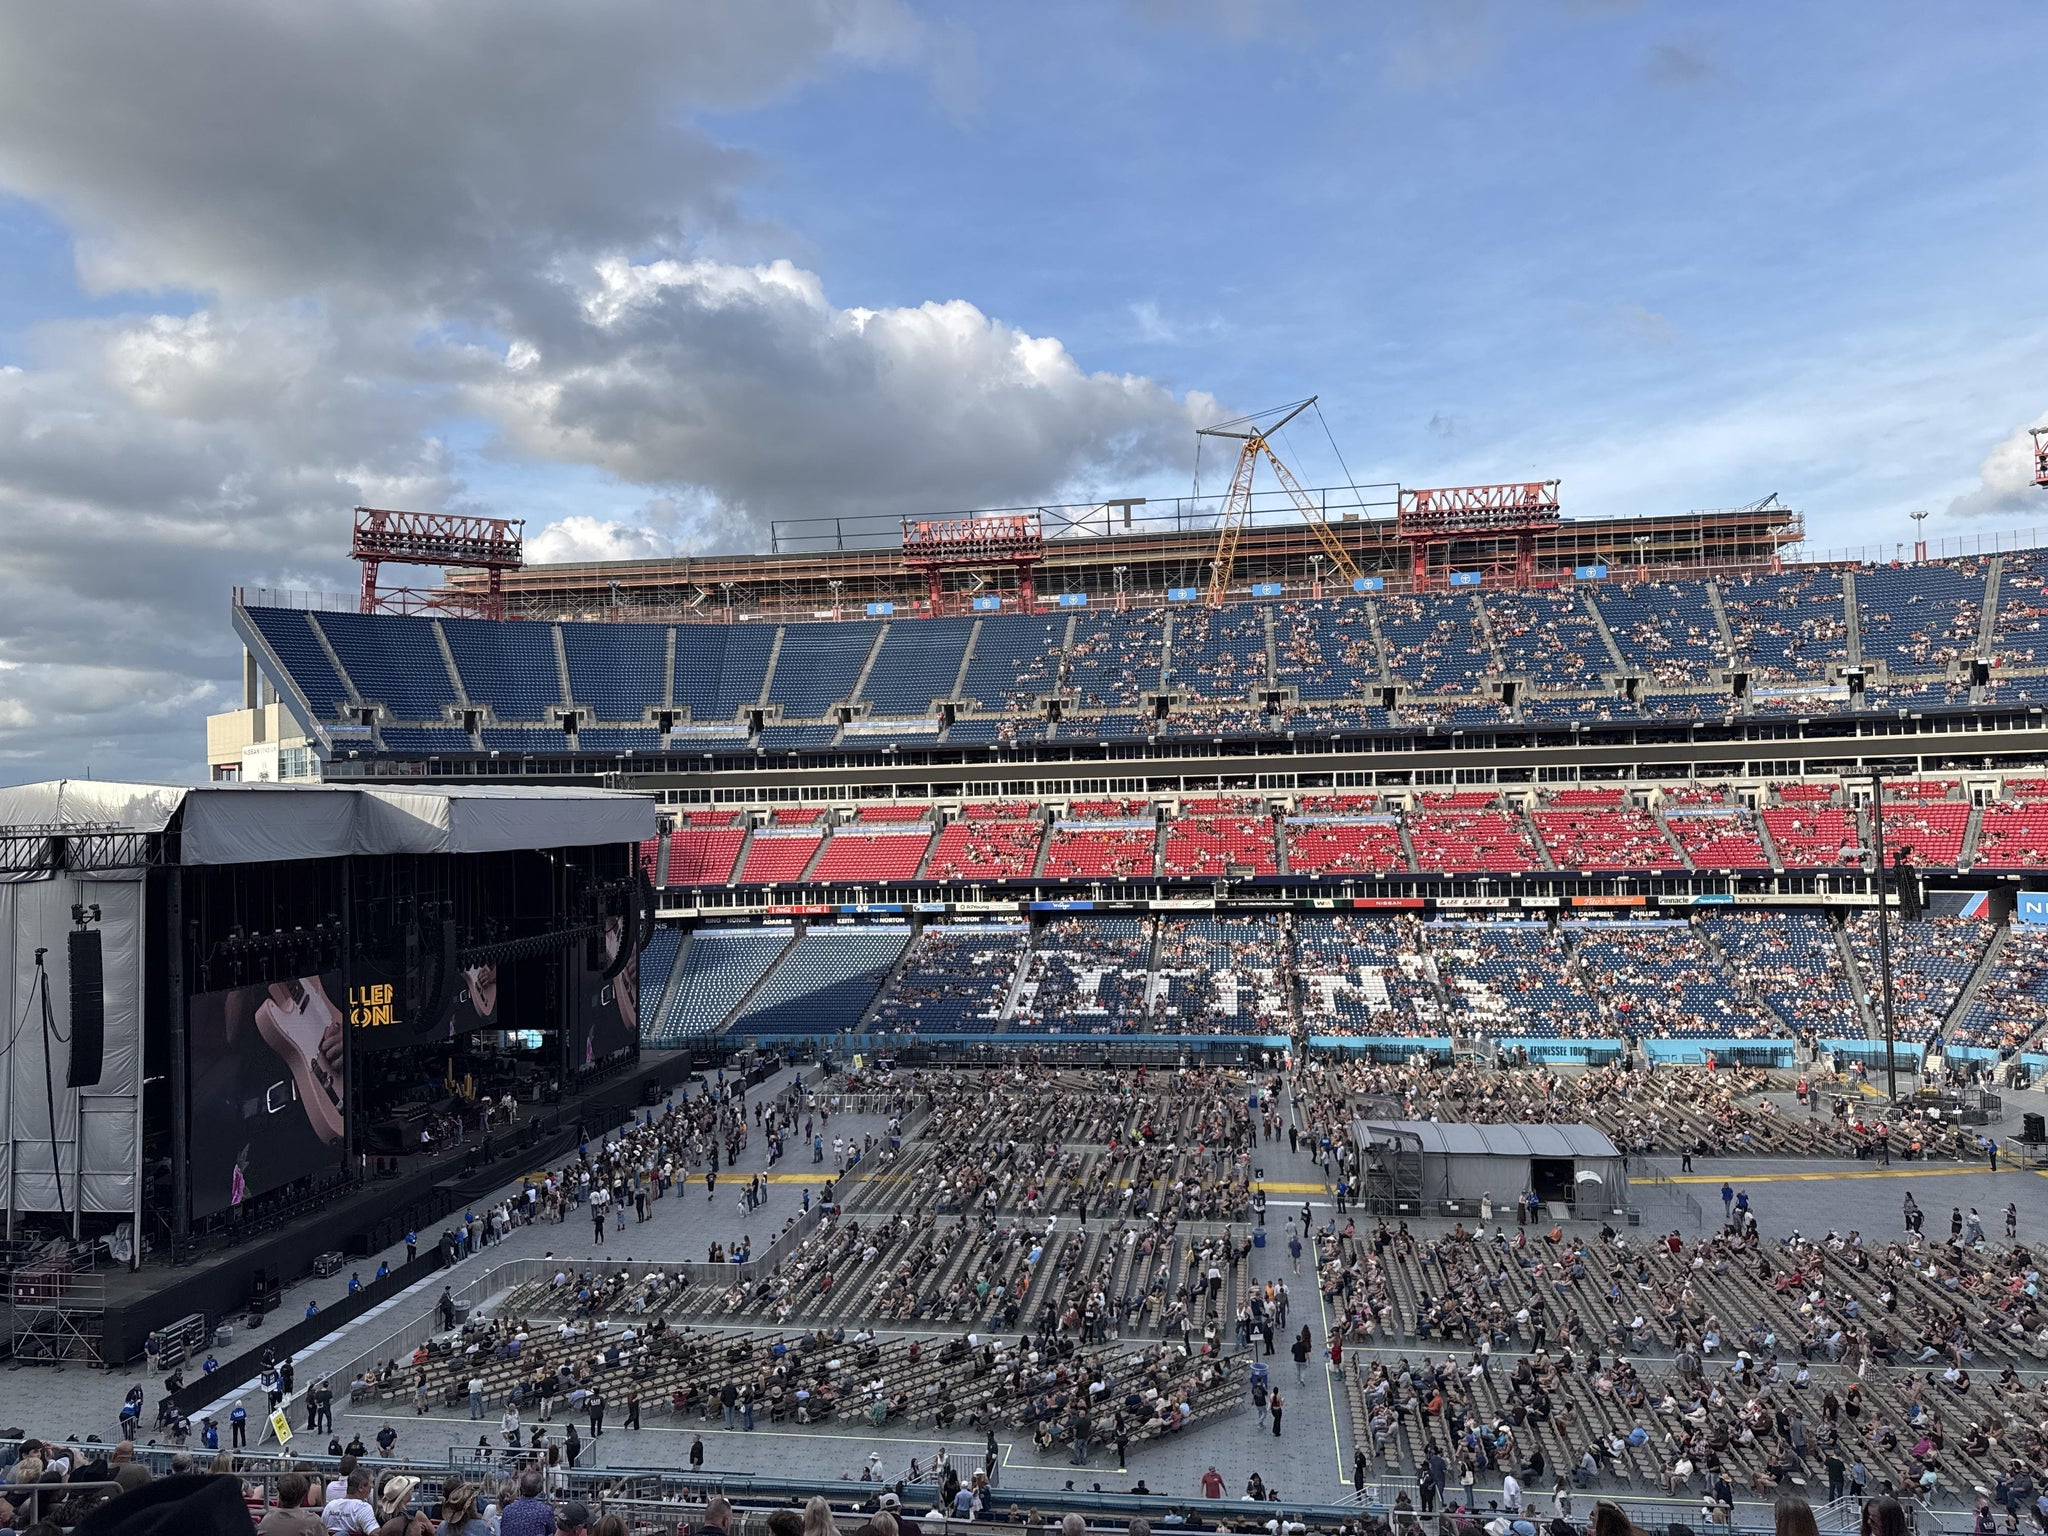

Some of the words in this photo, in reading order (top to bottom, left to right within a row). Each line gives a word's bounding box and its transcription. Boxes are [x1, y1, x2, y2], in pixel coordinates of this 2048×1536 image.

[1659, 896, 1689, 905] Pinnacle
[1530, 1046, 1568, 1056] TENNESSEE
[1569, 1046, 1593, 1057] TOUGH
[1729, 1046, 1768, 1057] TENNESSEE
[1253, 1325, 1260, 1334] A
